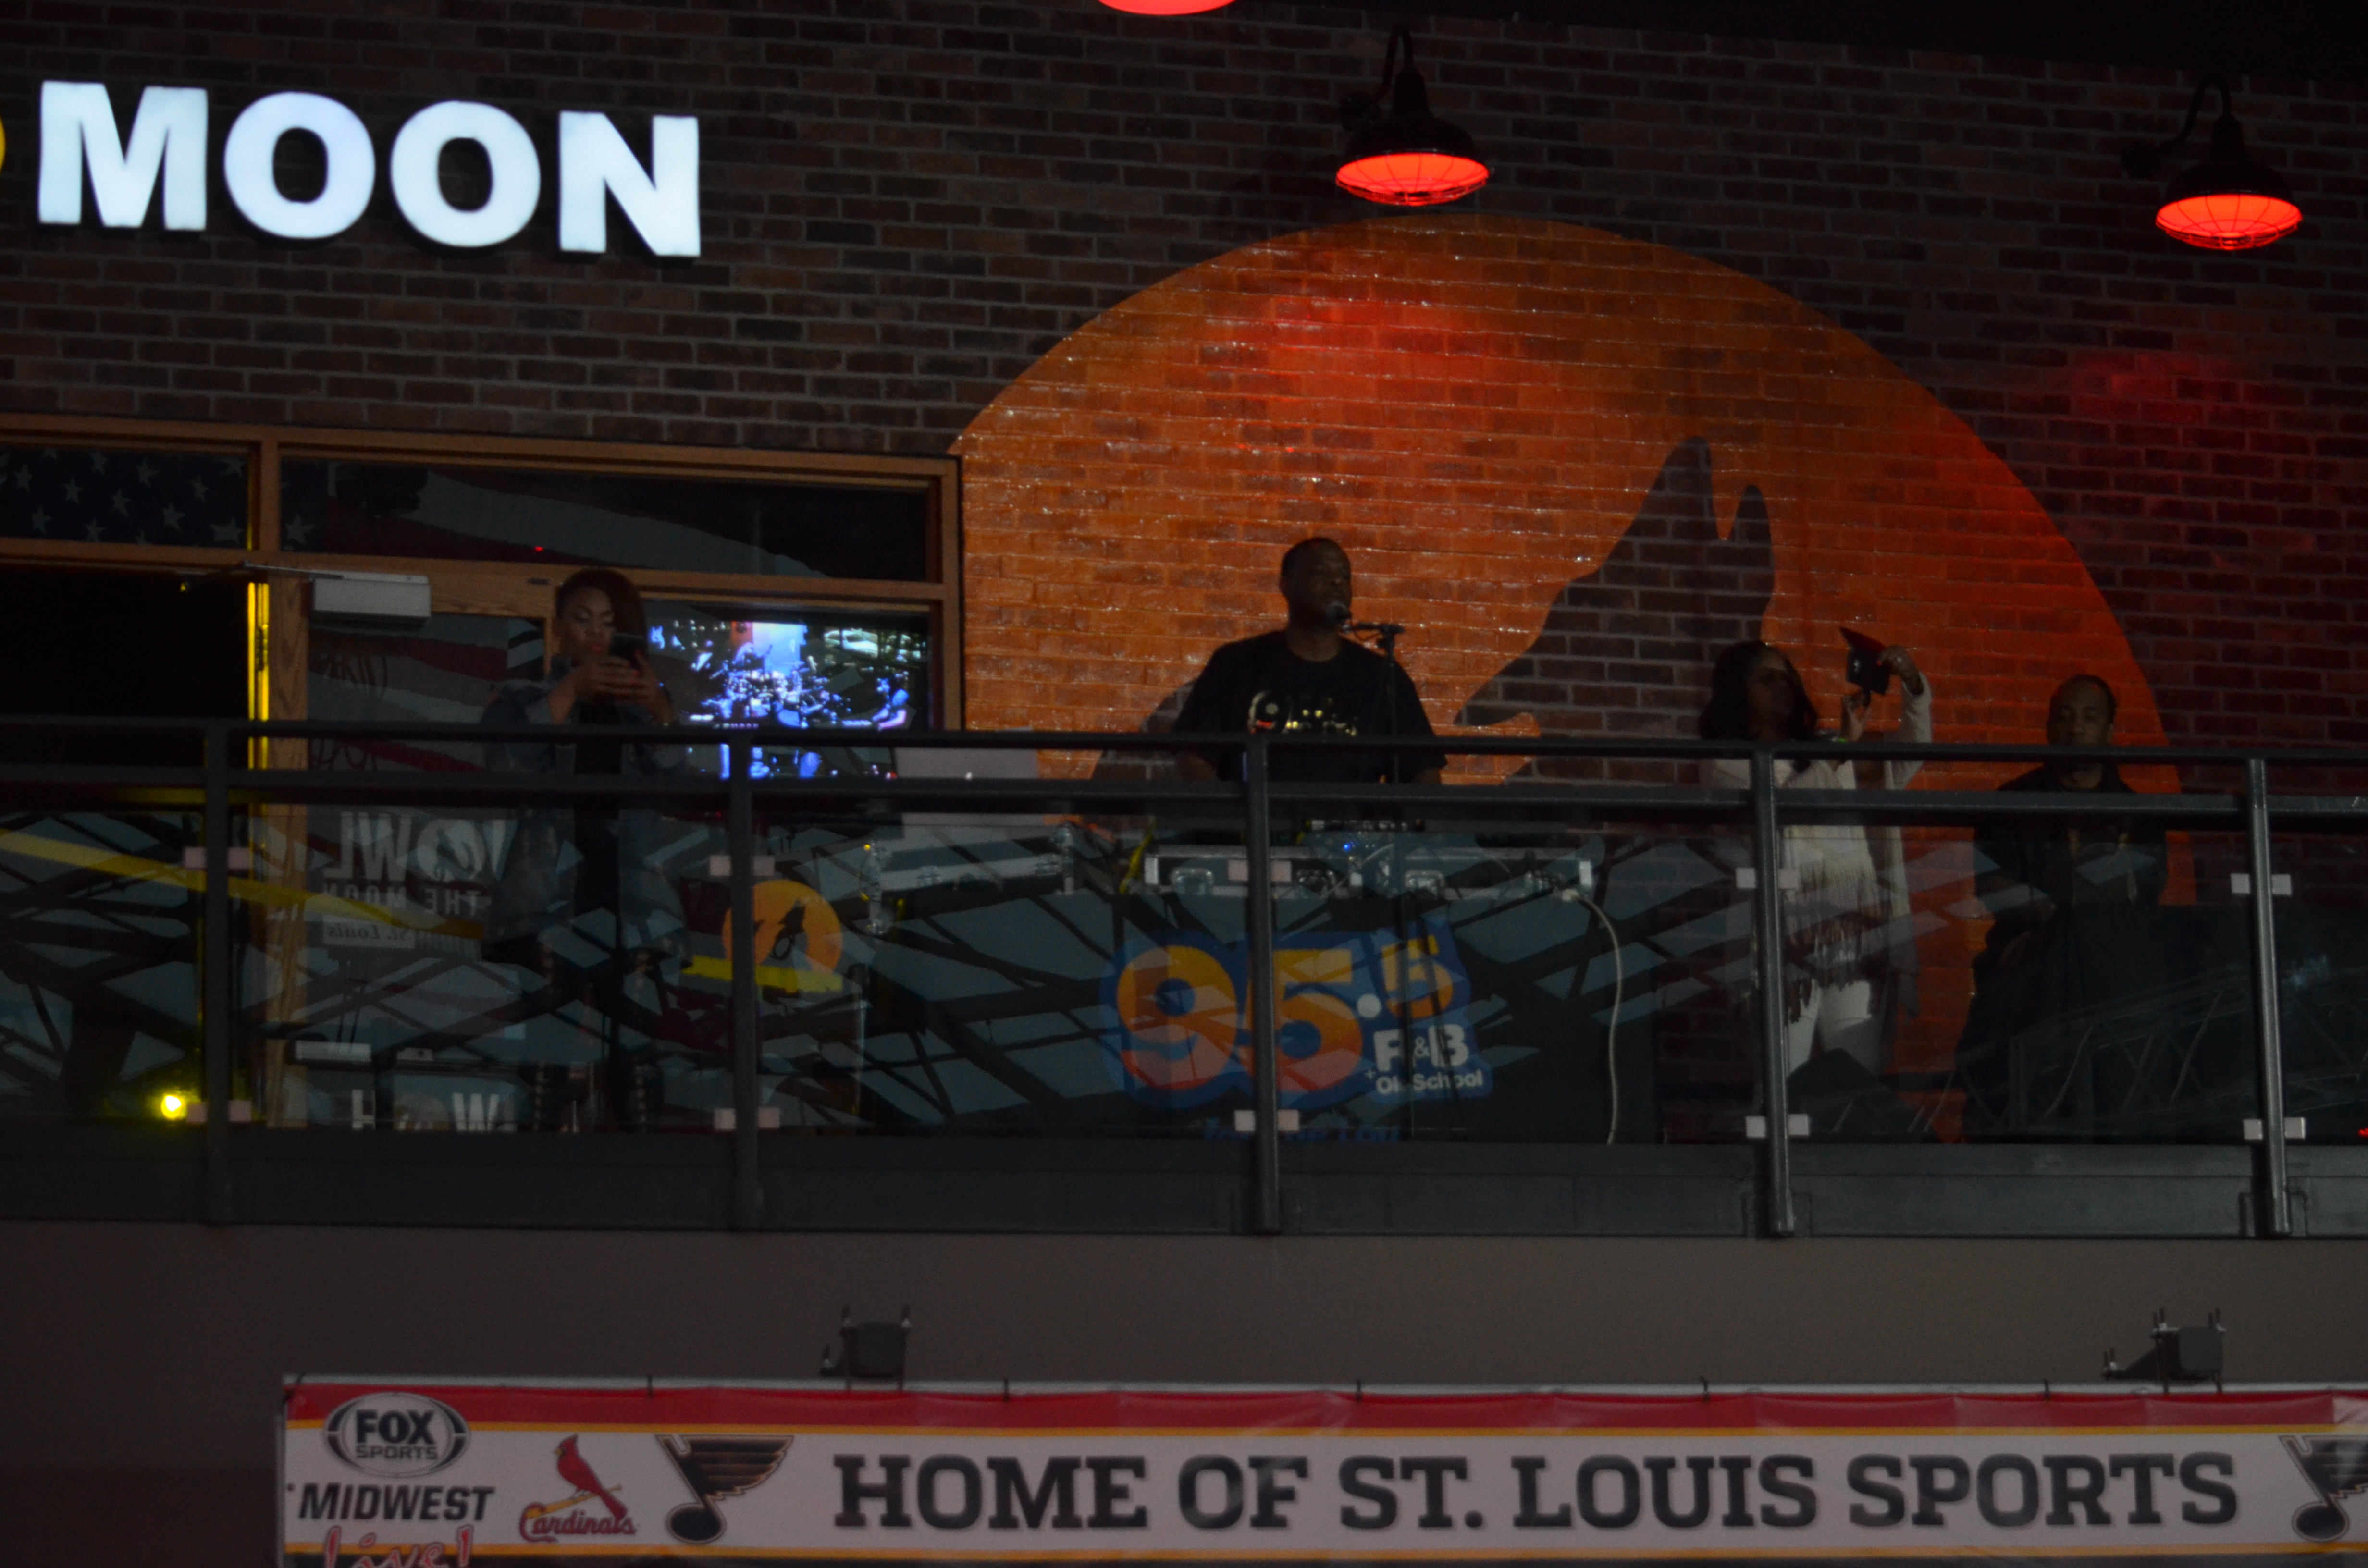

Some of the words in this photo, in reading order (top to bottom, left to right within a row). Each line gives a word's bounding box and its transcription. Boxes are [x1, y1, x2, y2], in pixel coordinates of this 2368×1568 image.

[37, 79, 701, 258] MOON
[1412, 1068, 1484, 1091] School
[355, 1409, 435, 1444] FOX
[355, 1444, 439, 1460] SPORTS
[298, 1482, 495, 1521] MIDWEST
[833, 1455, 1147, 1530] HOME
[1177, 1456, 1308, 1530] OF
[1339, 1455, 1484, 1530] ST.
[1511, 1455, 1817, 1530] LOUIS
[1847, 1453, 2238, 1528] SPORTS
[519, 1501, 637, 1542] Cardinals
